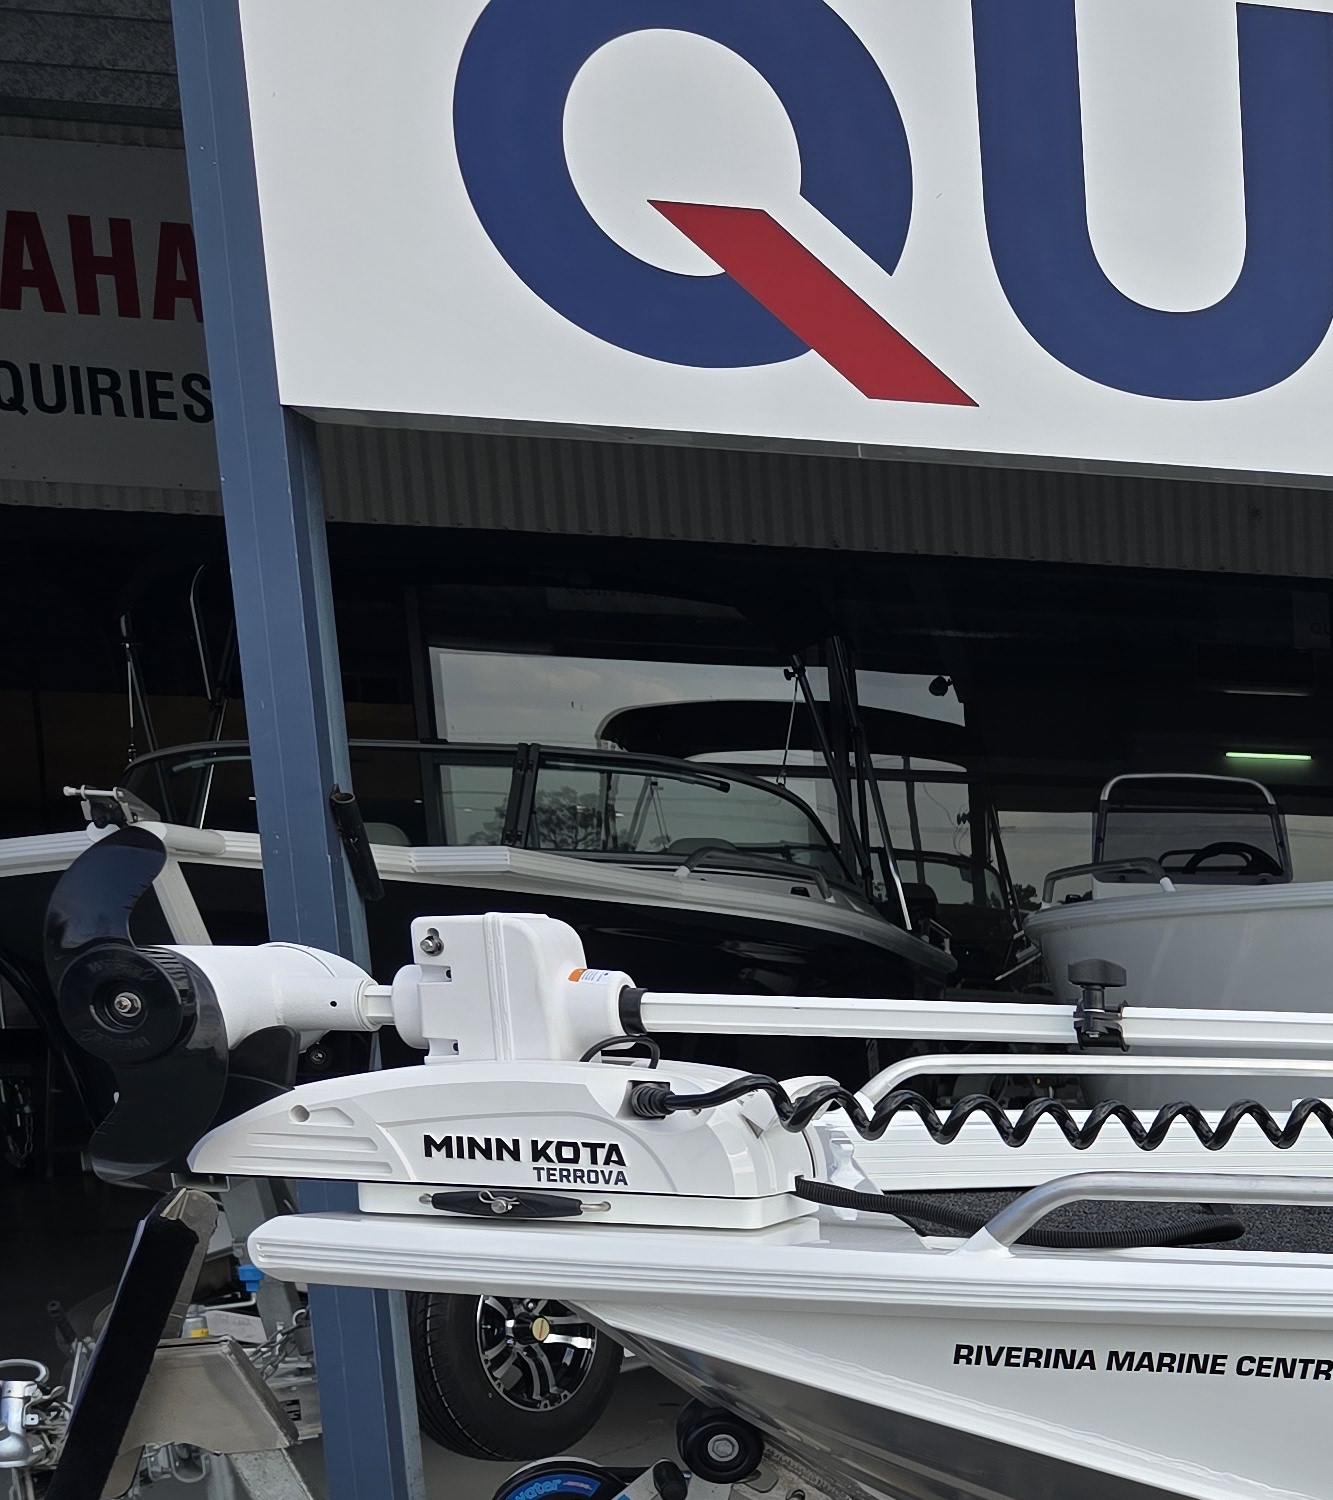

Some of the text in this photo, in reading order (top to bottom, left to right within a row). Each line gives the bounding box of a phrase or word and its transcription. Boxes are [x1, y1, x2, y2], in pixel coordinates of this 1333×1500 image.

[423, 1134, 627, 1167] MINN KOTA
[533, 1166, 628, 1185] TERROVA
[953, 1343, 1096, 1371] RIVERINA
[1106, 1350, 1228, 1375] MARINE
